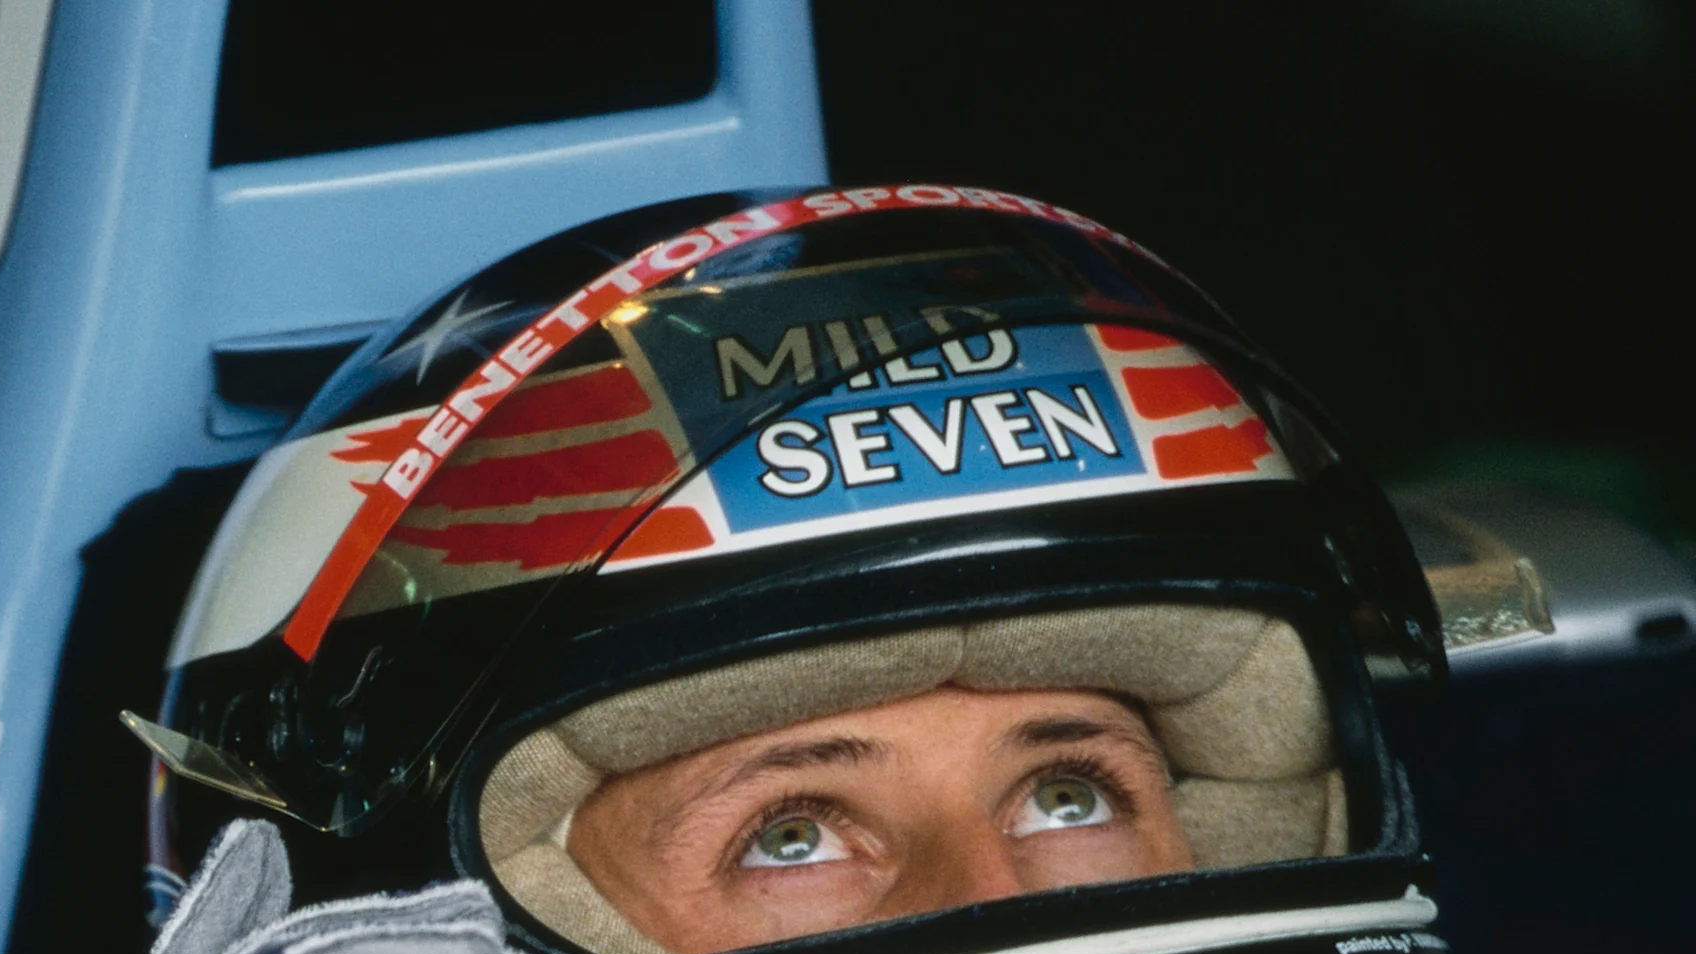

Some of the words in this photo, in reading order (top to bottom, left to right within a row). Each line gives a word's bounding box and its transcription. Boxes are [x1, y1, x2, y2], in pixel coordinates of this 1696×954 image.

[383, 206, 782, 500] BENETTON
[714, 303, 1018, 398] MILD
[757, 384, 1122, 498] SEVEN
